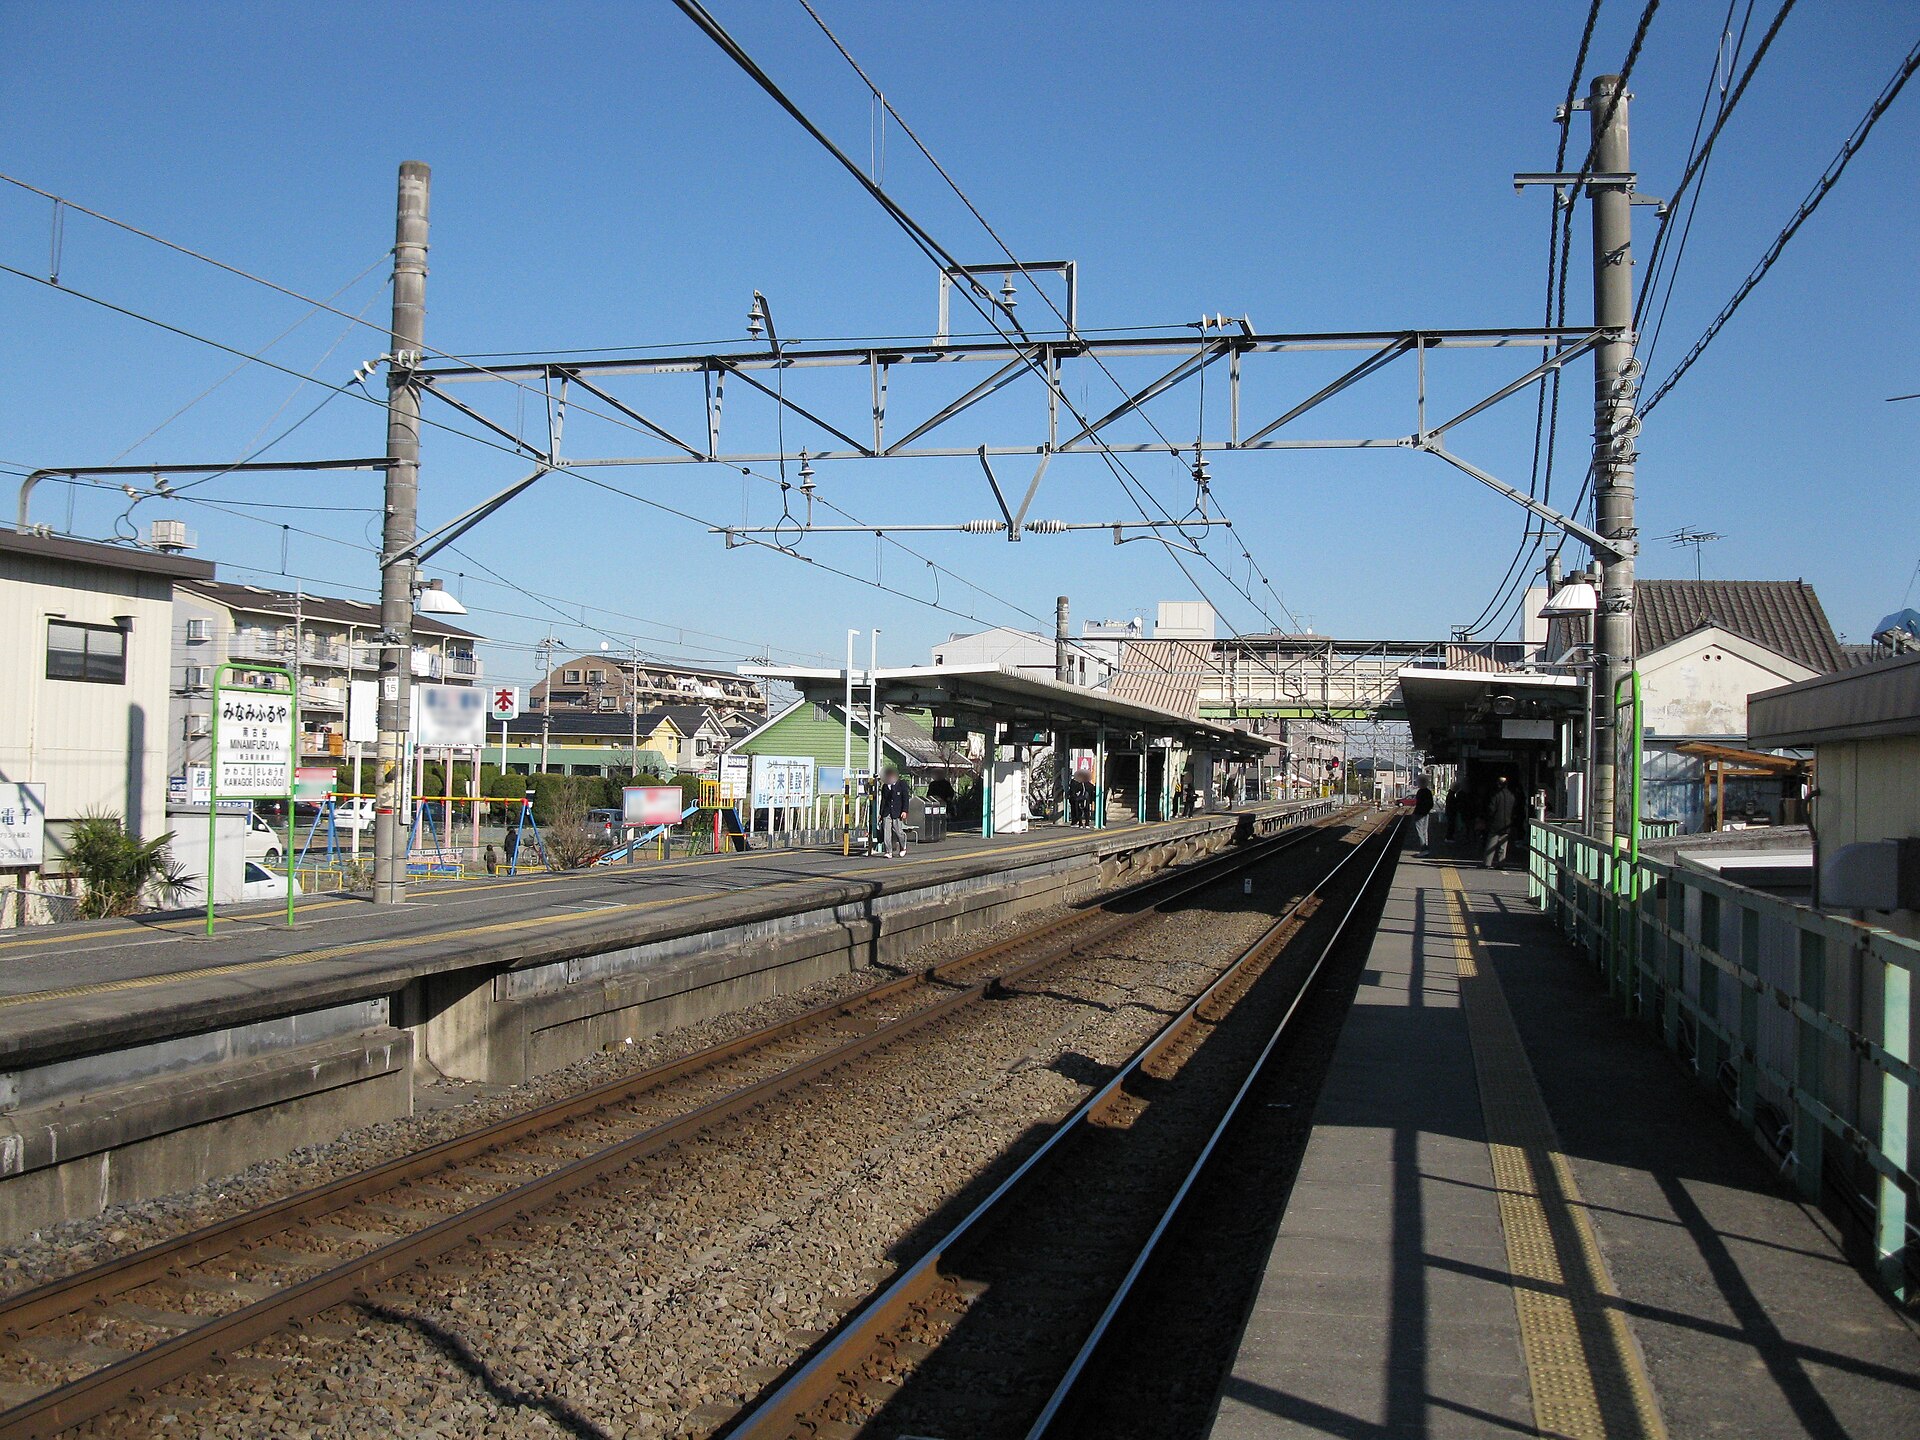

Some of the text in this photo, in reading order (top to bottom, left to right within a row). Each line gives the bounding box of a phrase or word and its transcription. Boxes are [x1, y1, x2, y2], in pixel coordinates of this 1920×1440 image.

[386, 684, 397, 693] 15
[494, 688, 514, 712] 本
[223, 702, 287, 723] みなみふるや
[242, 727, 268, 738] 南古谷
[230, 739, 280, 750] MINAMIFURUYA
[224, 778, 253, 787] KAWAGOE
[1, 807, 32, 825] 電子
